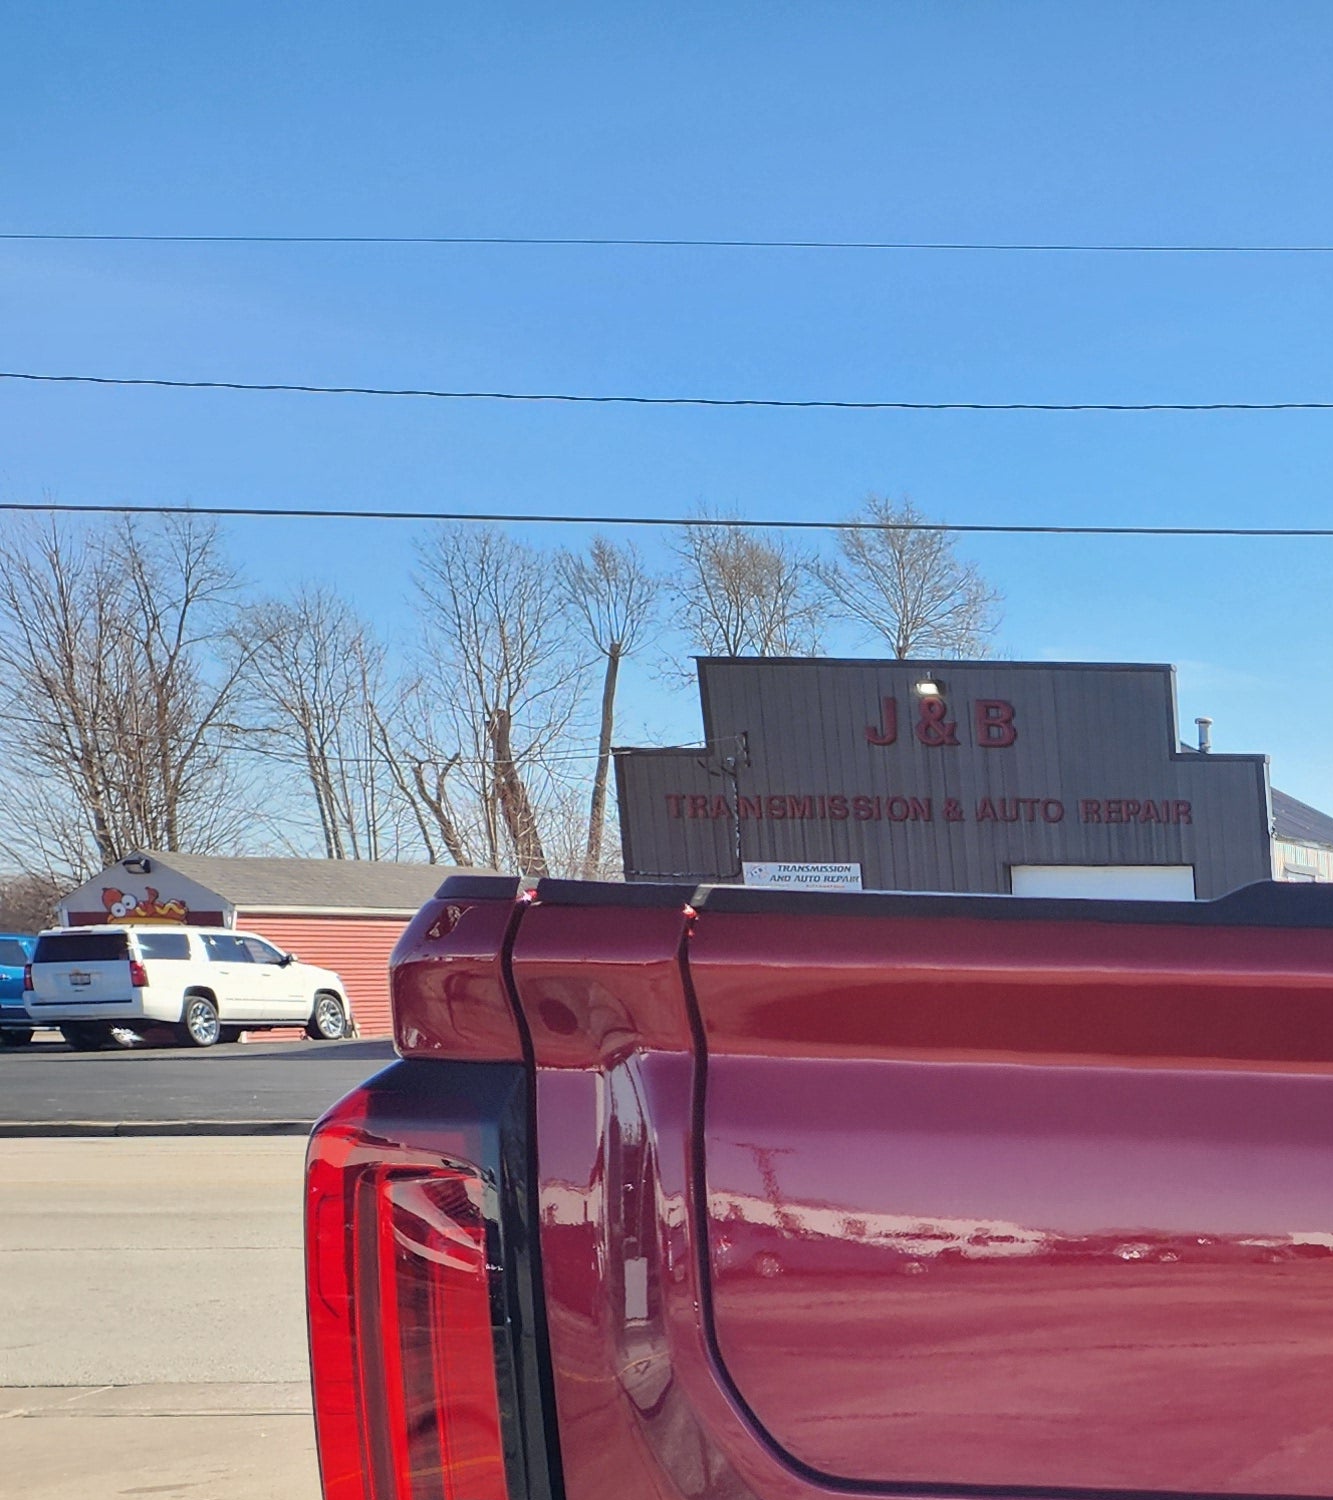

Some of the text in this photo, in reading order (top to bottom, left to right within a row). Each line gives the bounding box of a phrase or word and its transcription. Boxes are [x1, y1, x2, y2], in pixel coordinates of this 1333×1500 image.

[864, 695, 1018, 748] J & B
[664, 794, 1193, 825] TRANSMISSION & AUTO REPAIR
[777, 864, 852, 873] TRANSMISSION
[769, 875, 791, 883] AND
[793, 875, 821, 883] AUTO
